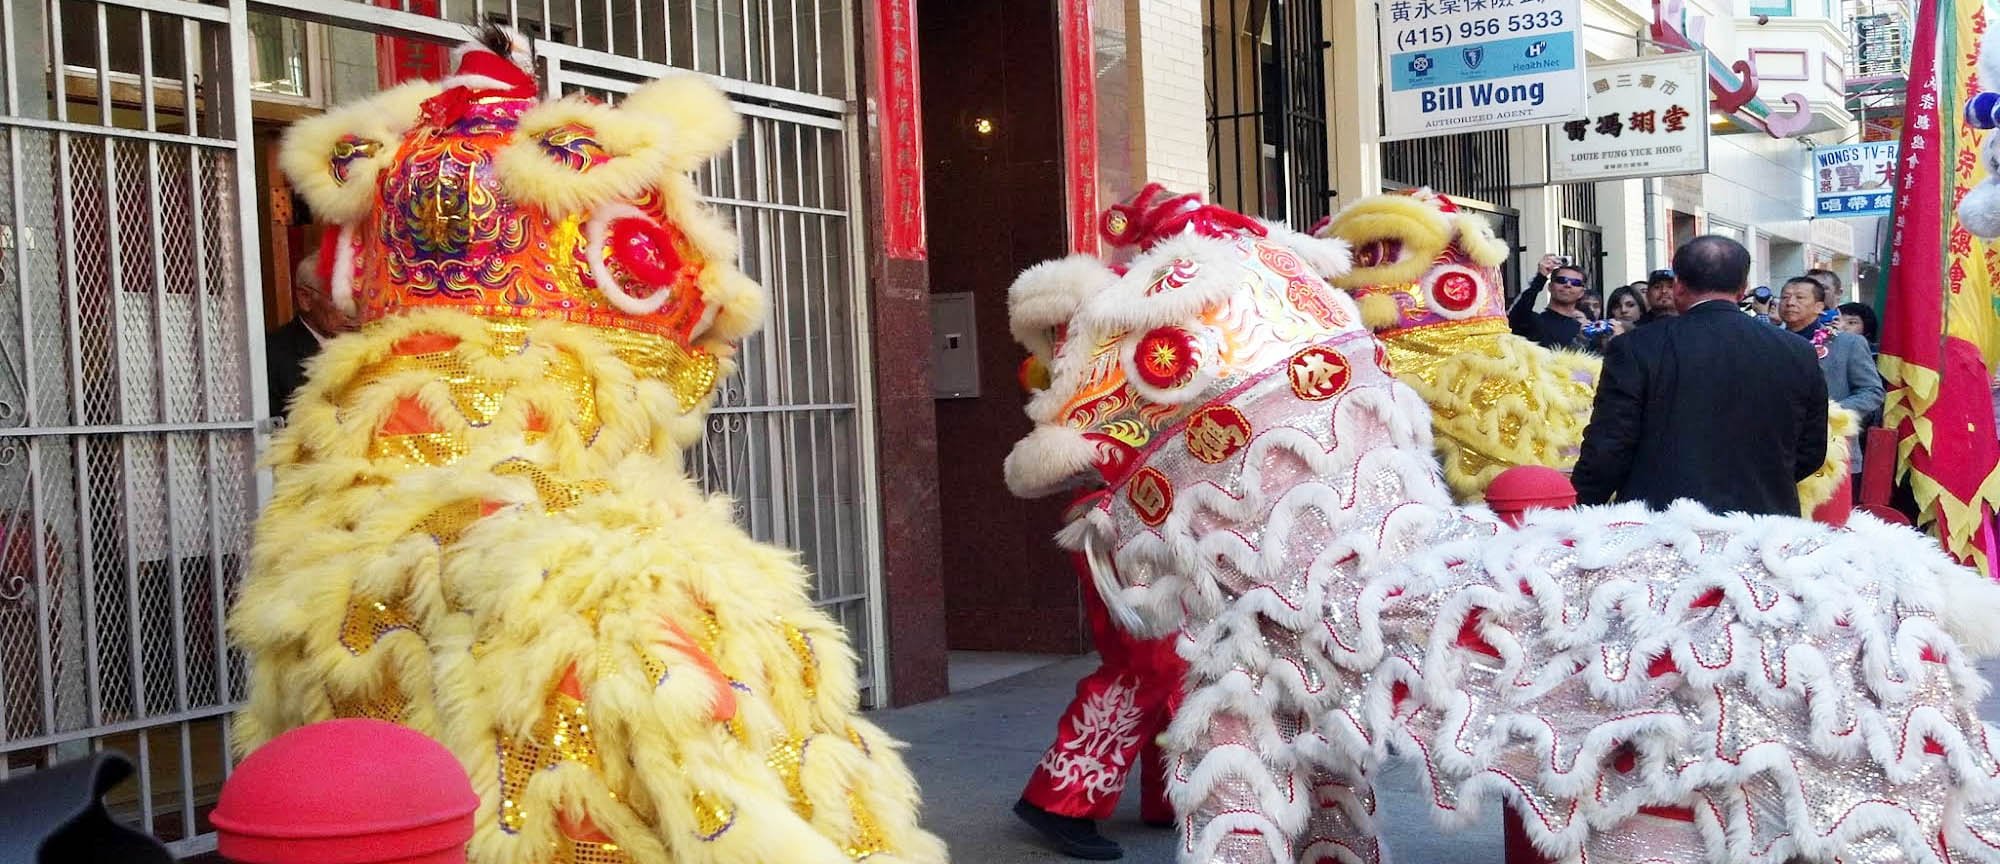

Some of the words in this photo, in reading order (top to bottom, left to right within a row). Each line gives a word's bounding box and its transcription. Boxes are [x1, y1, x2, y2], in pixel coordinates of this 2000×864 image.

[1397, 24, 1452, 51] (415)
[1460, 18, 1500, 39] 956
[1508, 10, 1563, 32] 5333
[1513, 61, 1542, 72] Health
[1543, 58, 1560, 68] Net
[1421, 86, 1463, 113] Bill
[1469, 82, 1545, 106] Wong
[1425, 114, 1494, 128] AUTHORIZED
[1496, 109, 1534, 120] AGENT
[1571, 151, 1599, 162] LOUIE
[1601, 149, 1627, 159] FUNG
[1655, 145, 1683, 155] HONG
[1818, 148, 1859, 167] WONG'S
